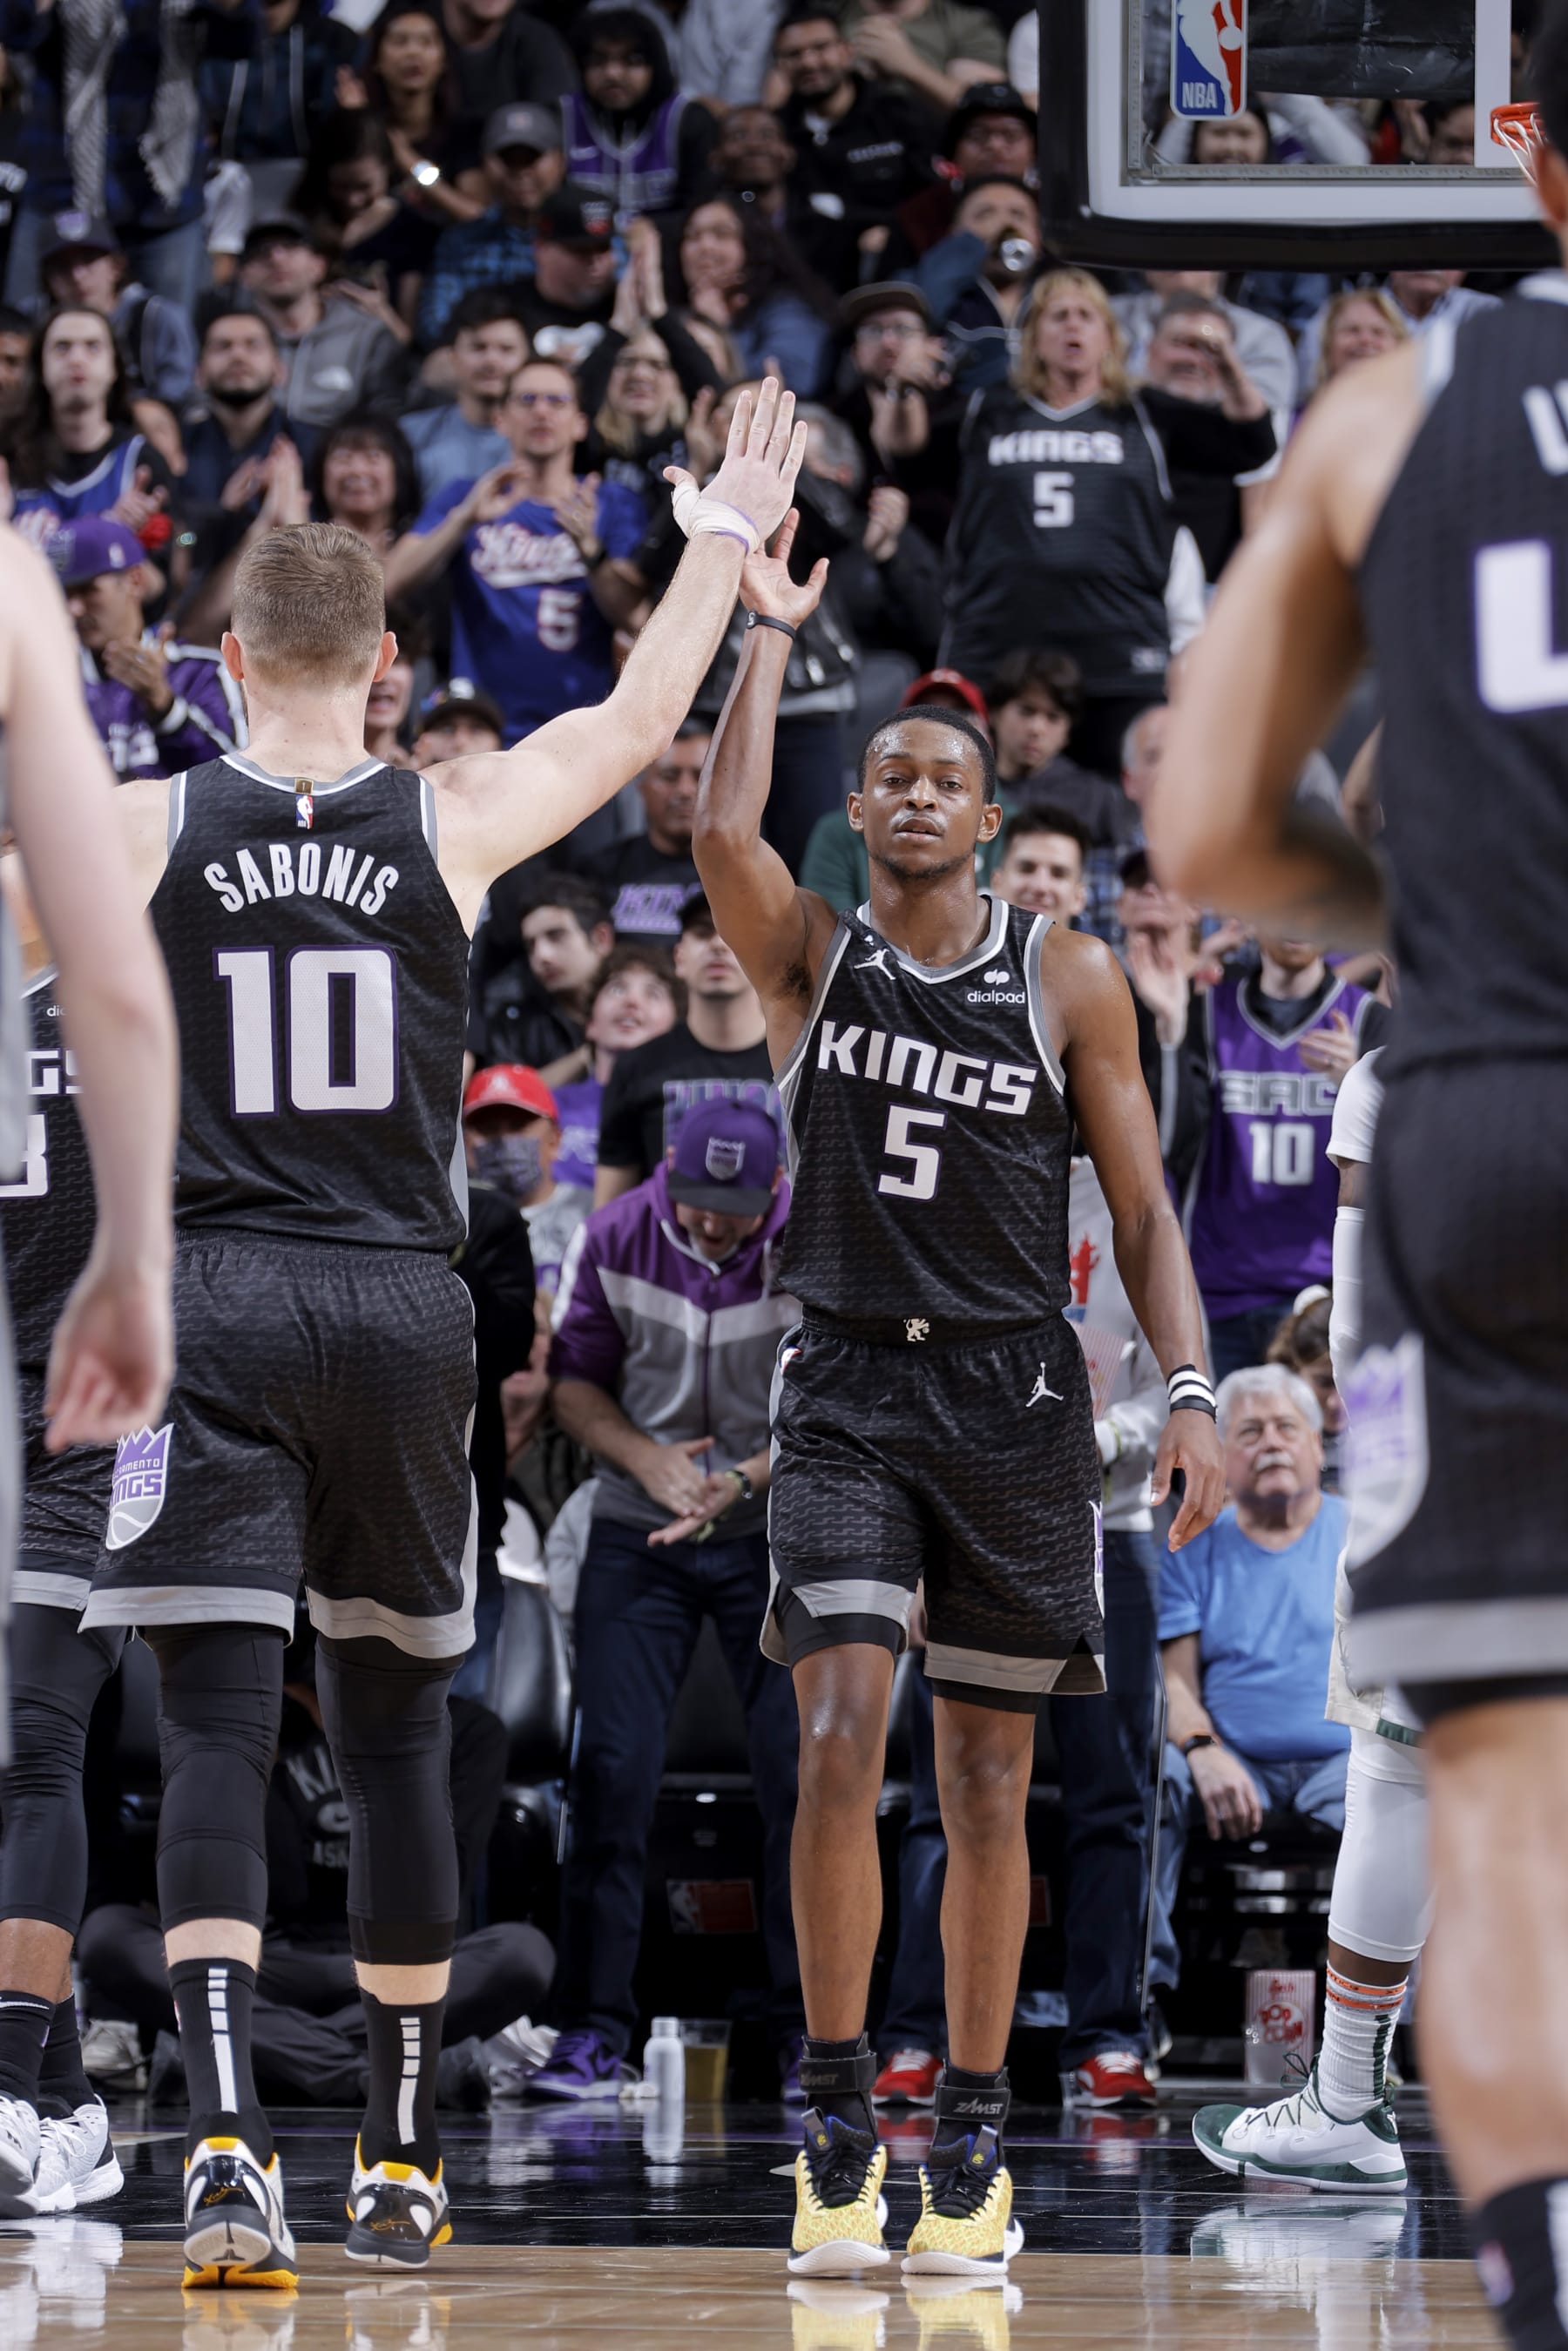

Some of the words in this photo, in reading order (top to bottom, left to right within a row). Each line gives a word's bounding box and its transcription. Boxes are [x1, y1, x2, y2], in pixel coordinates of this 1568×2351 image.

[1182, 82, 1218, 109] NBA
[988, 430, 1124, 466] KINGS
[1034, 471, 1075, 528] 5
[538, 588, 580, 651] 5
[204, 842, 400, 915] SABONIS
[967, 990, 1025, 1005] dialpad
[214, 946, 398, 1116] 10
[817, 1019, 1038, 1116] KINGS
[877, 1104, 946, 1200] 5
[1249, 1122, 1315, 1186] 10
